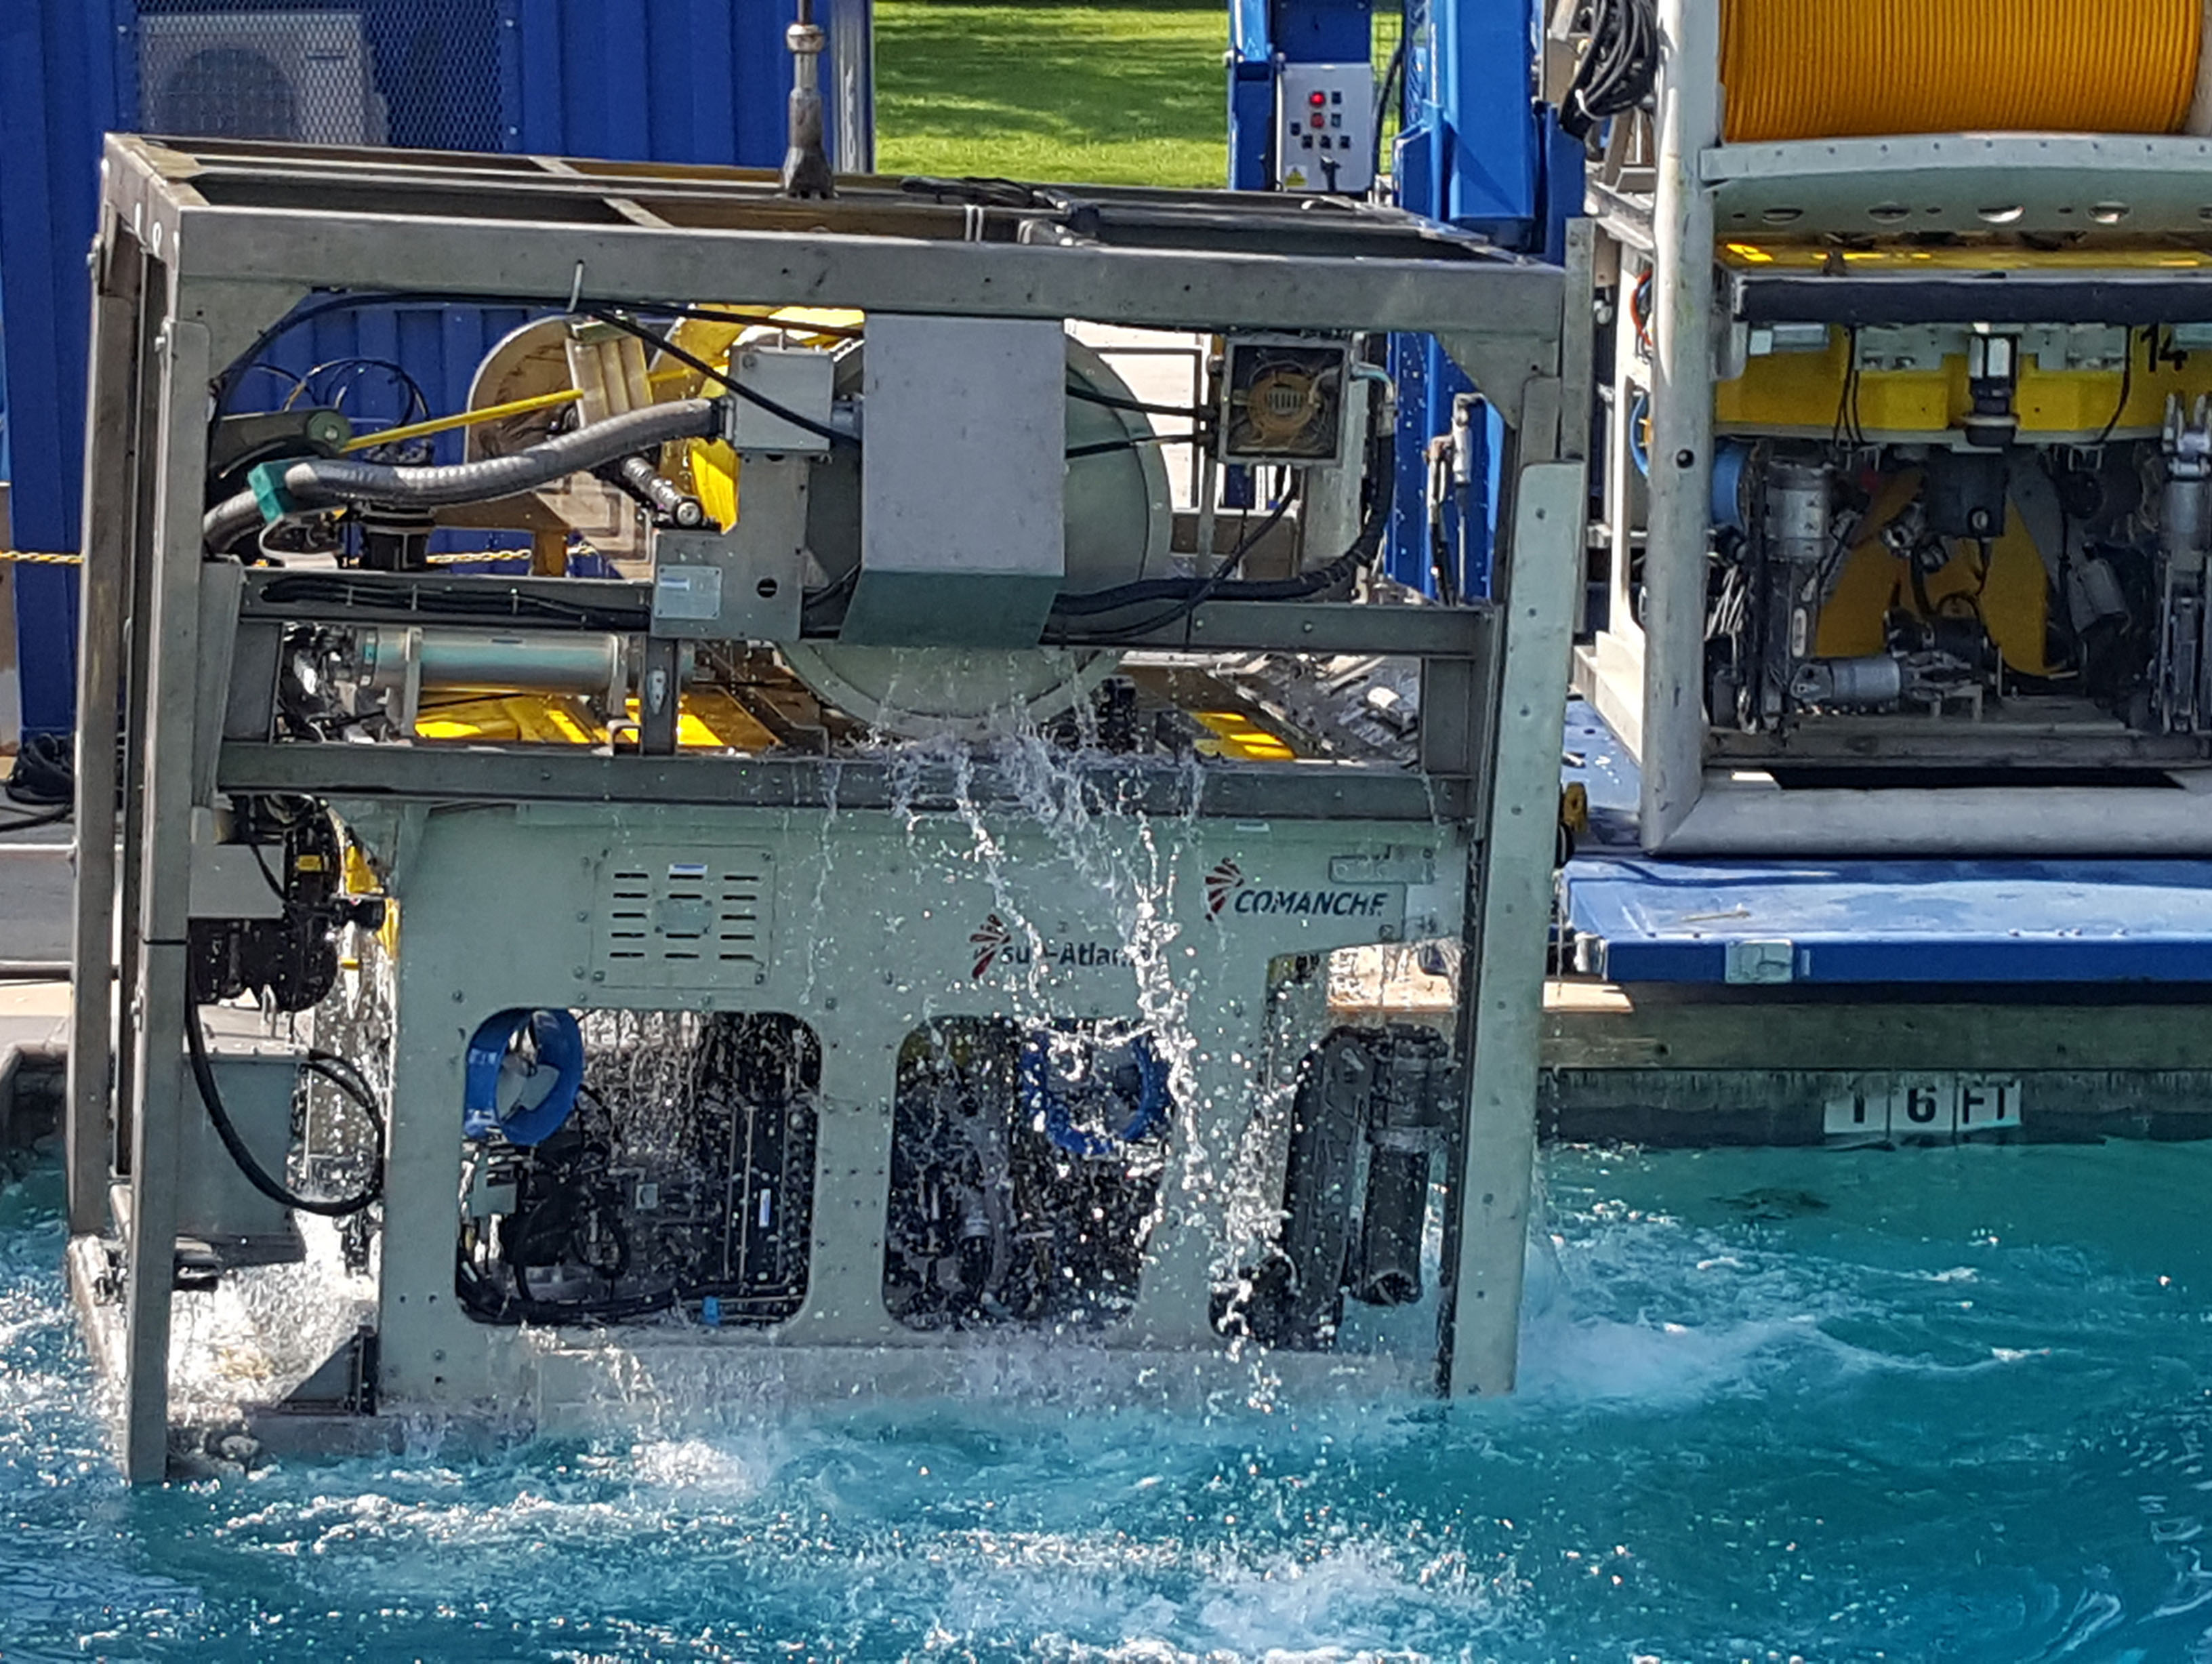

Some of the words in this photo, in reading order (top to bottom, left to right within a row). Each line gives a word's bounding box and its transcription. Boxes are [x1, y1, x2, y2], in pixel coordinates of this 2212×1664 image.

[2139, 323, 2188, 372] 14
[1234, 889, 1387, 916] COMANCHE
[1961, 1079, 2017, 1124] FT
